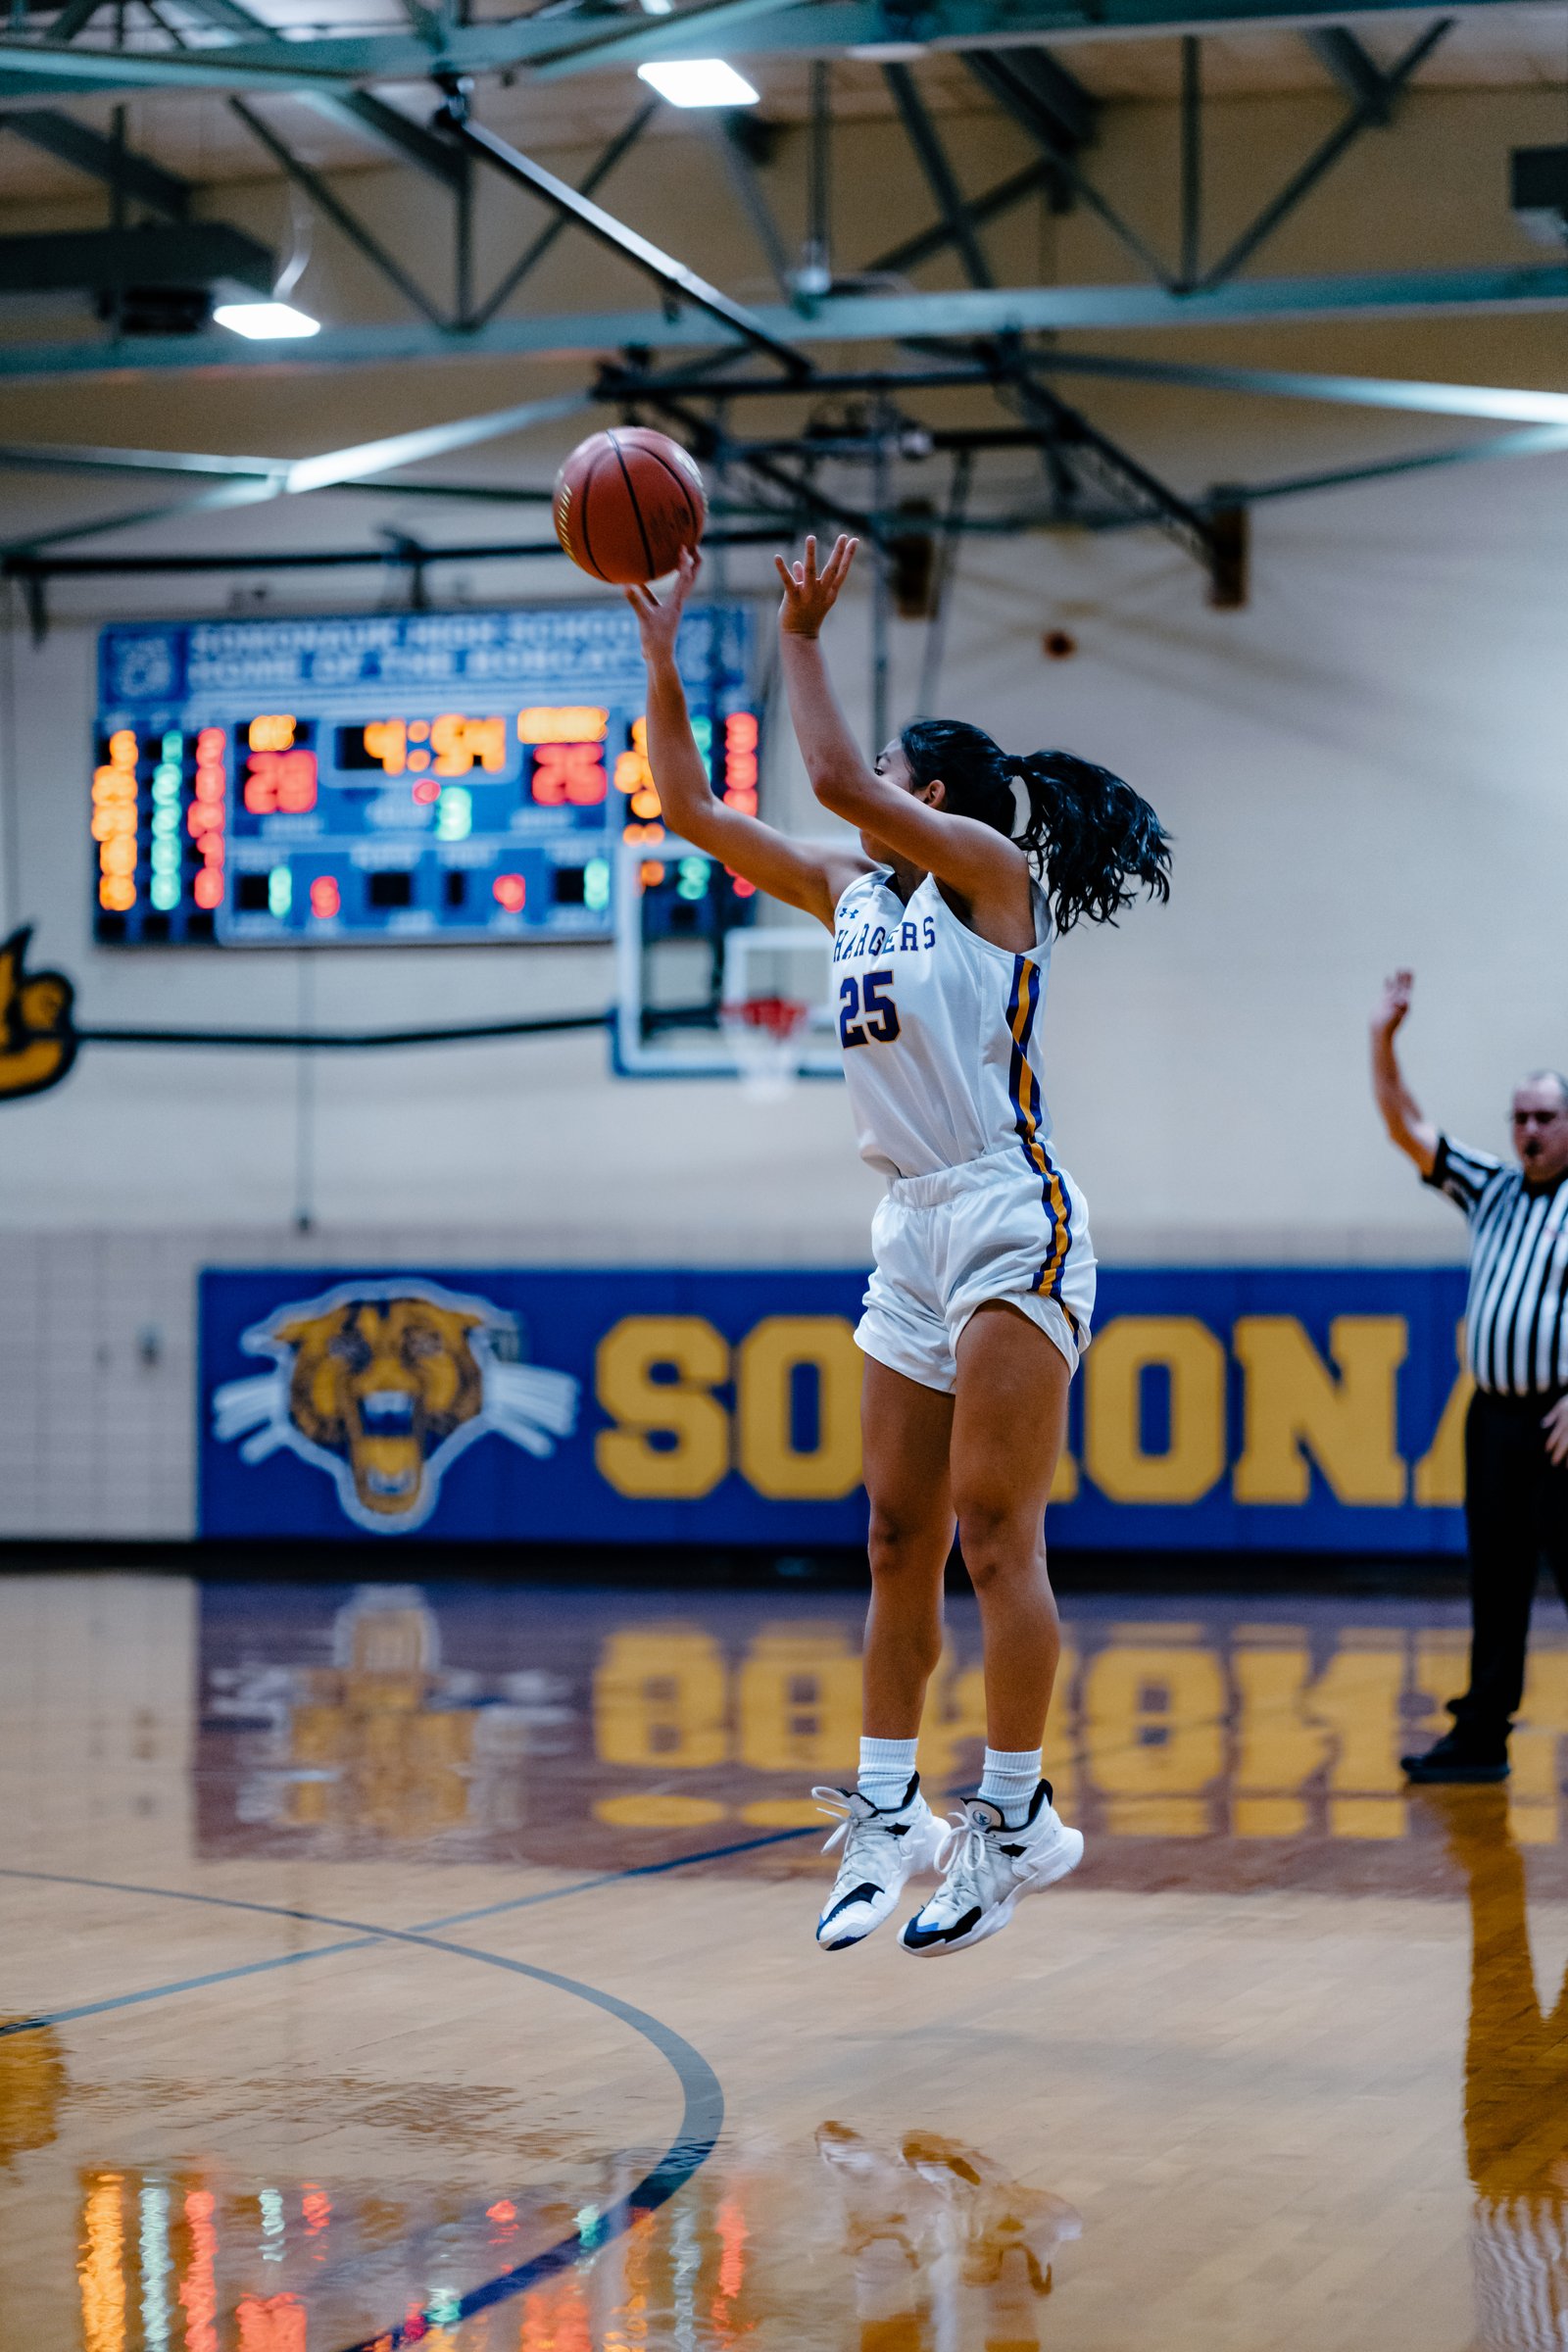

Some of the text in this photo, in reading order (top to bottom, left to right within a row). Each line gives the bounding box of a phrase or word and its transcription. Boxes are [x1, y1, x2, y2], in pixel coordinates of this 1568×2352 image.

[833, 915, 936, 962] HARGERS
[839, 969, 901, 1050] 25
[594, 1314, 1468, 1506] SOON
